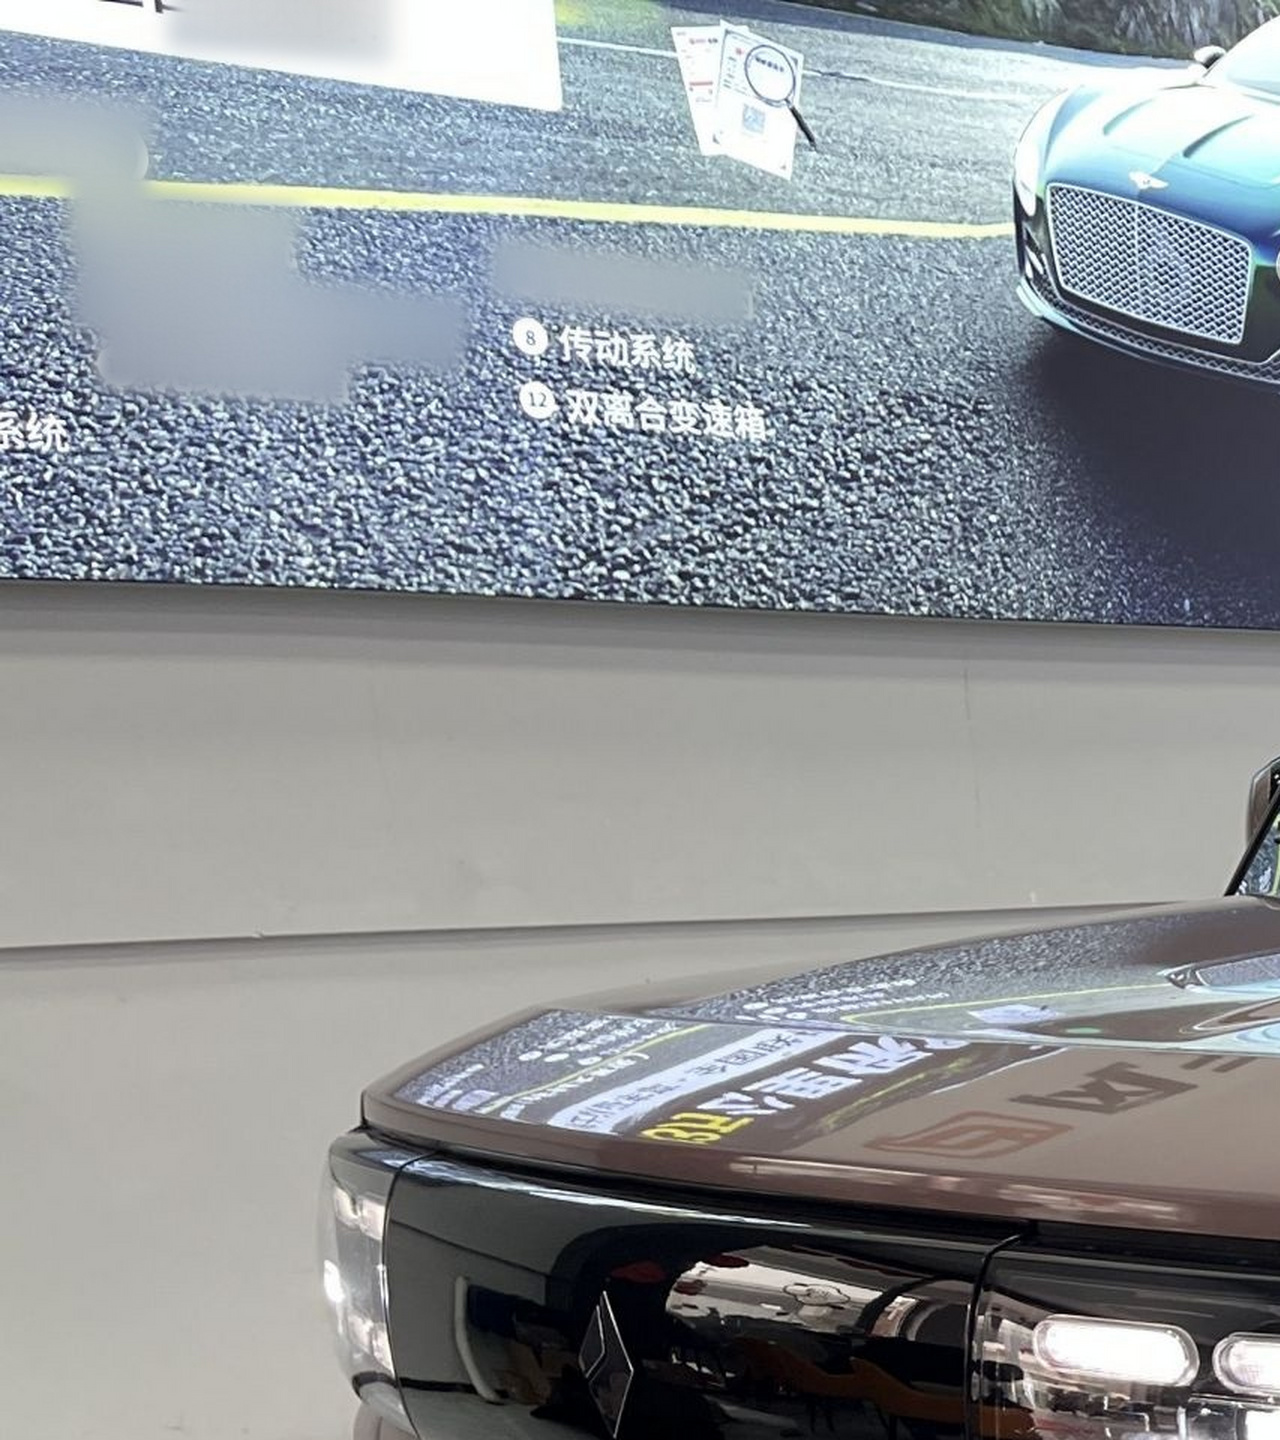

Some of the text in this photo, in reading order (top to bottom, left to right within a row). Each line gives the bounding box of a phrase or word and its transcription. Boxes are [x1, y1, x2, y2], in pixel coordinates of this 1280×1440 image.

[558, 324, 697, 375] 传动系统
[564, 388, 770, 443] 双离合变速箱
